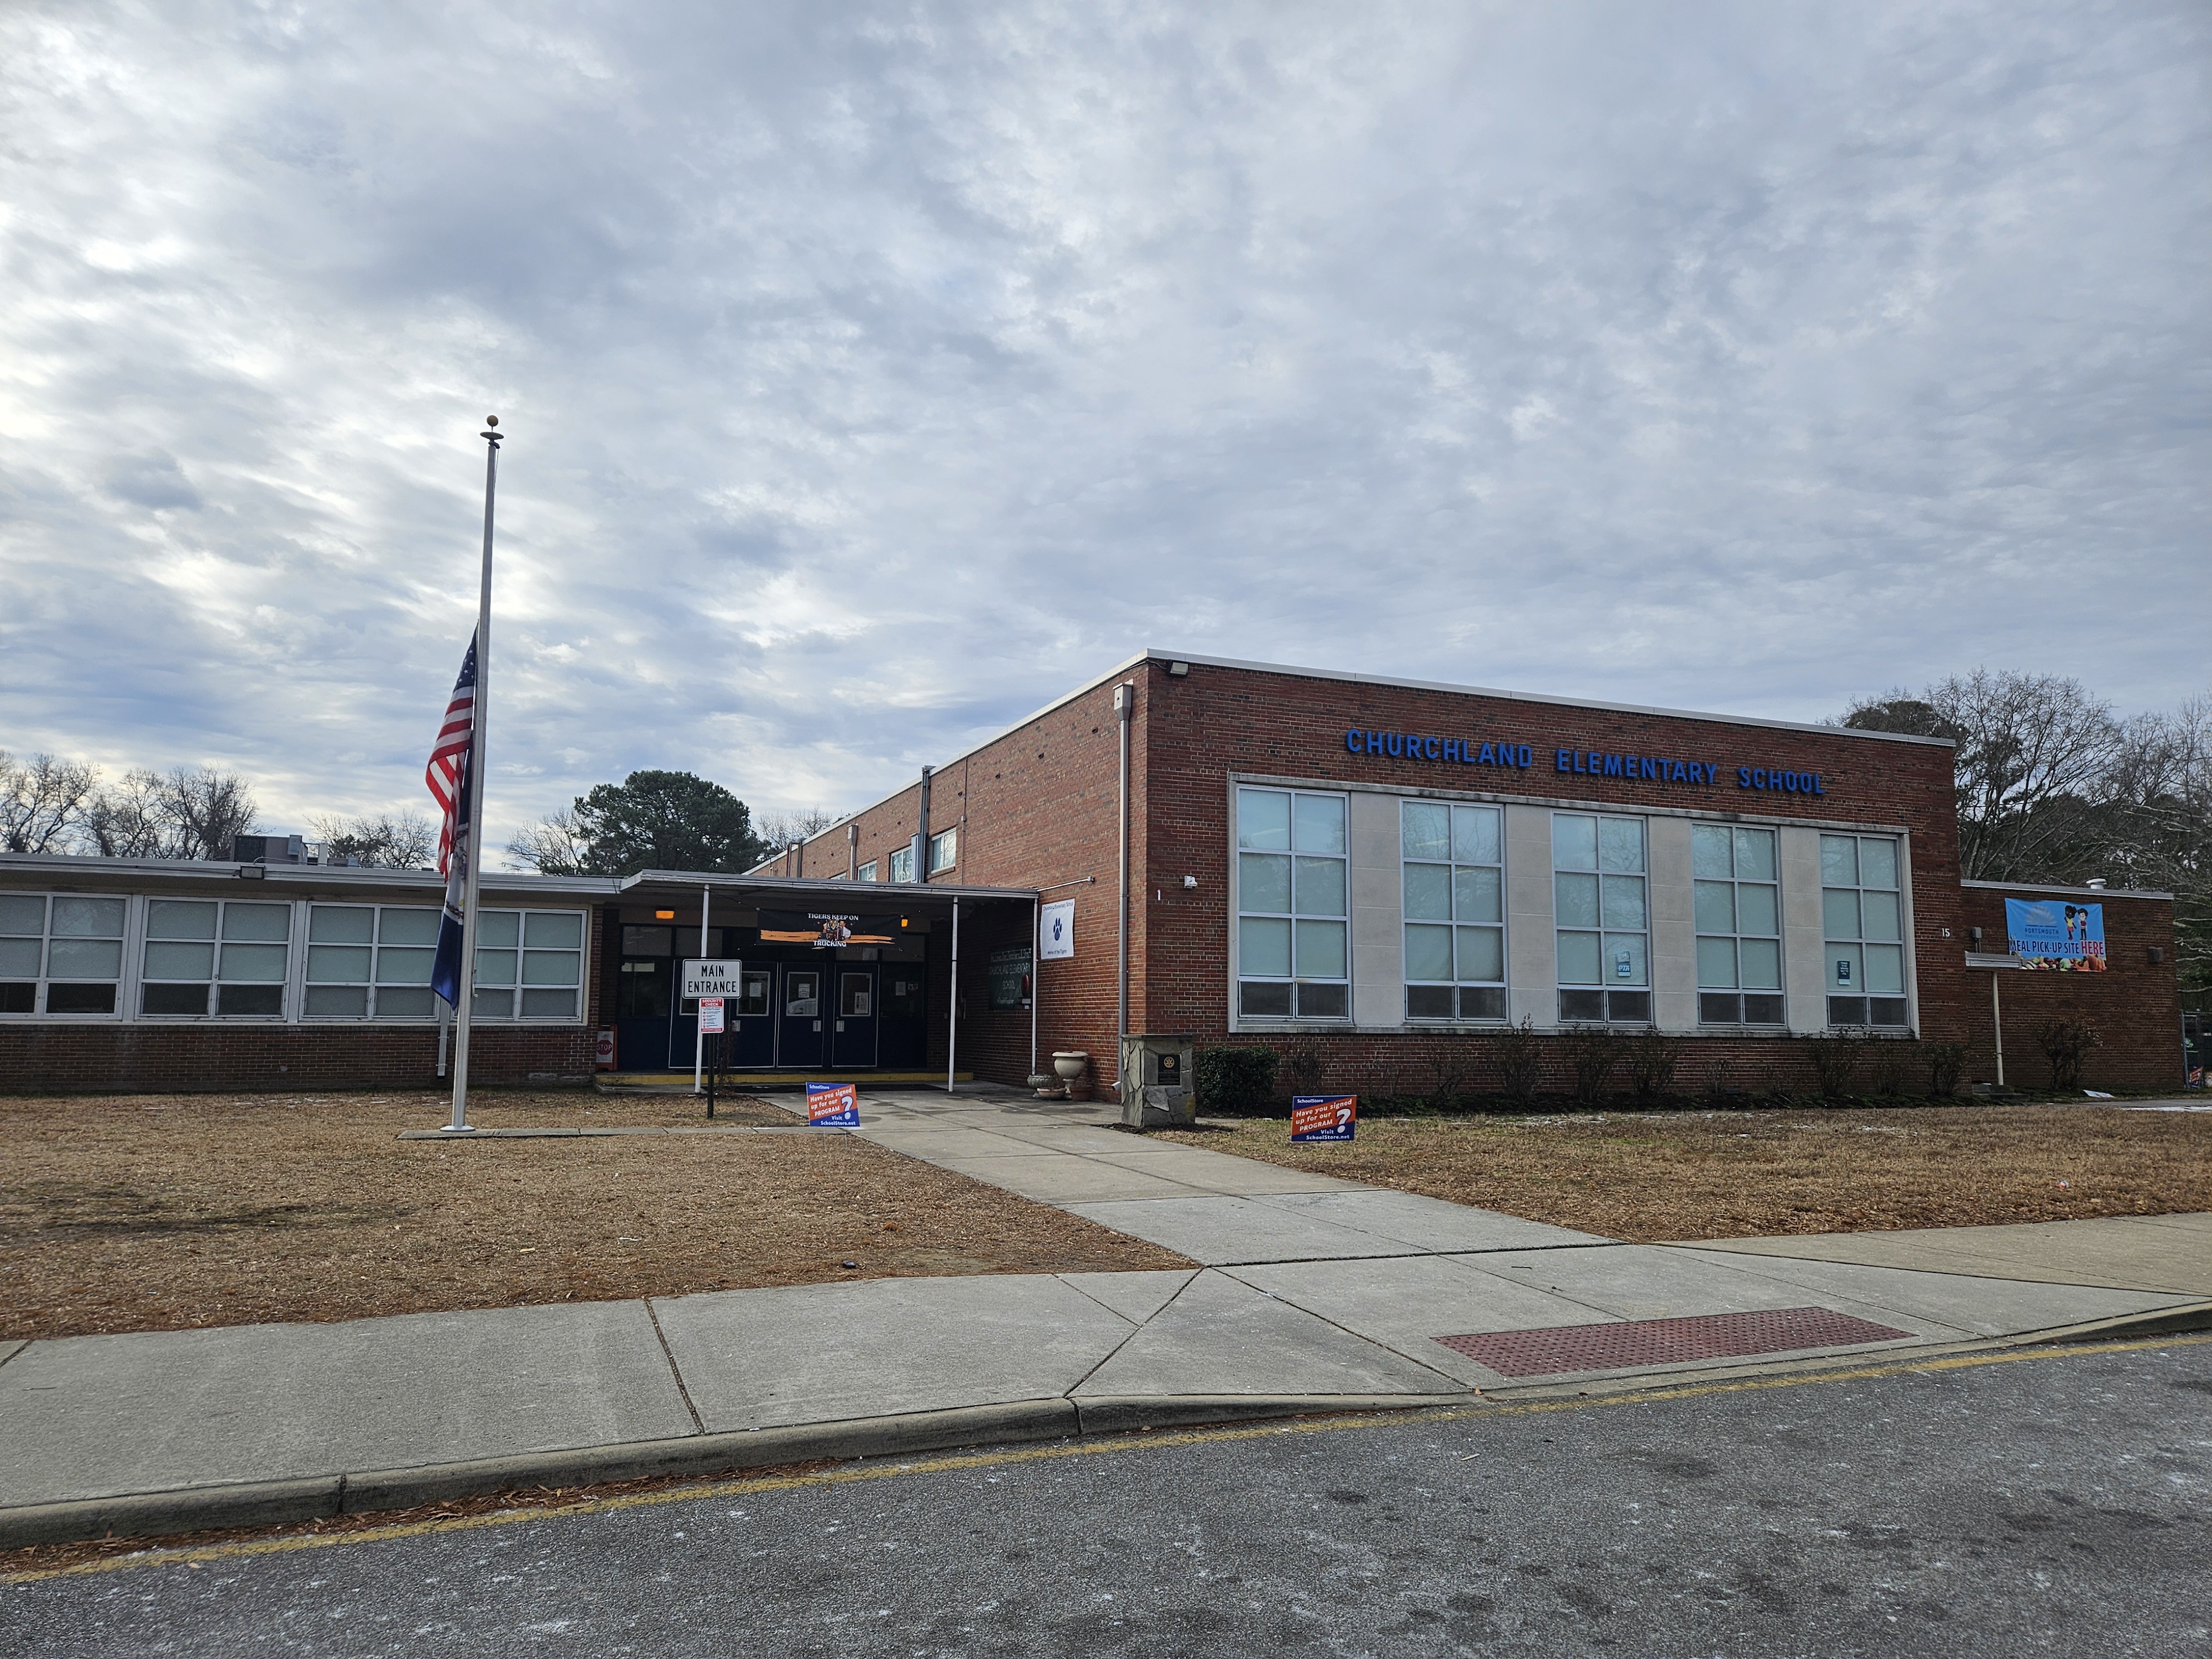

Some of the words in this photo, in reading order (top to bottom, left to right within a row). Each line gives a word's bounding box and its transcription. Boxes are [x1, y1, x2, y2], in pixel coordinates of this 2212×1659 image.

[1347, 728, 1532, 768] CHURCHLAND
[1555, 748, 1718, 785] ELEMENTARY
[1738, 766, 1826, 795] SCHOOL
[1157, 889, 1161, 901] 1
[1942, 928, 1950, 937] 15
[813, 939, 847, 947] TRUCKING
[2010, 940, 2030, 952] MEAL
[2032, 941, 2062, 953] PICK-UP
[2064, 942, 2080, 954] SITE
[2081, 941, 2105, 954] HERE
[701, 965, 724, 977] MAIN
[688, 981, 737, 993] ENTRANCE
[835, 1087, 852, 1097] signed
[814, 1105, 840, 1117] PROGRAM
[1296, 1109, 1313, 1118] Have
[1314, 1106, 1328, 1115] you
[1329, 1098, 1353, 1110] signed
[1300, 1119, 1333, 1132] PROGRAM
